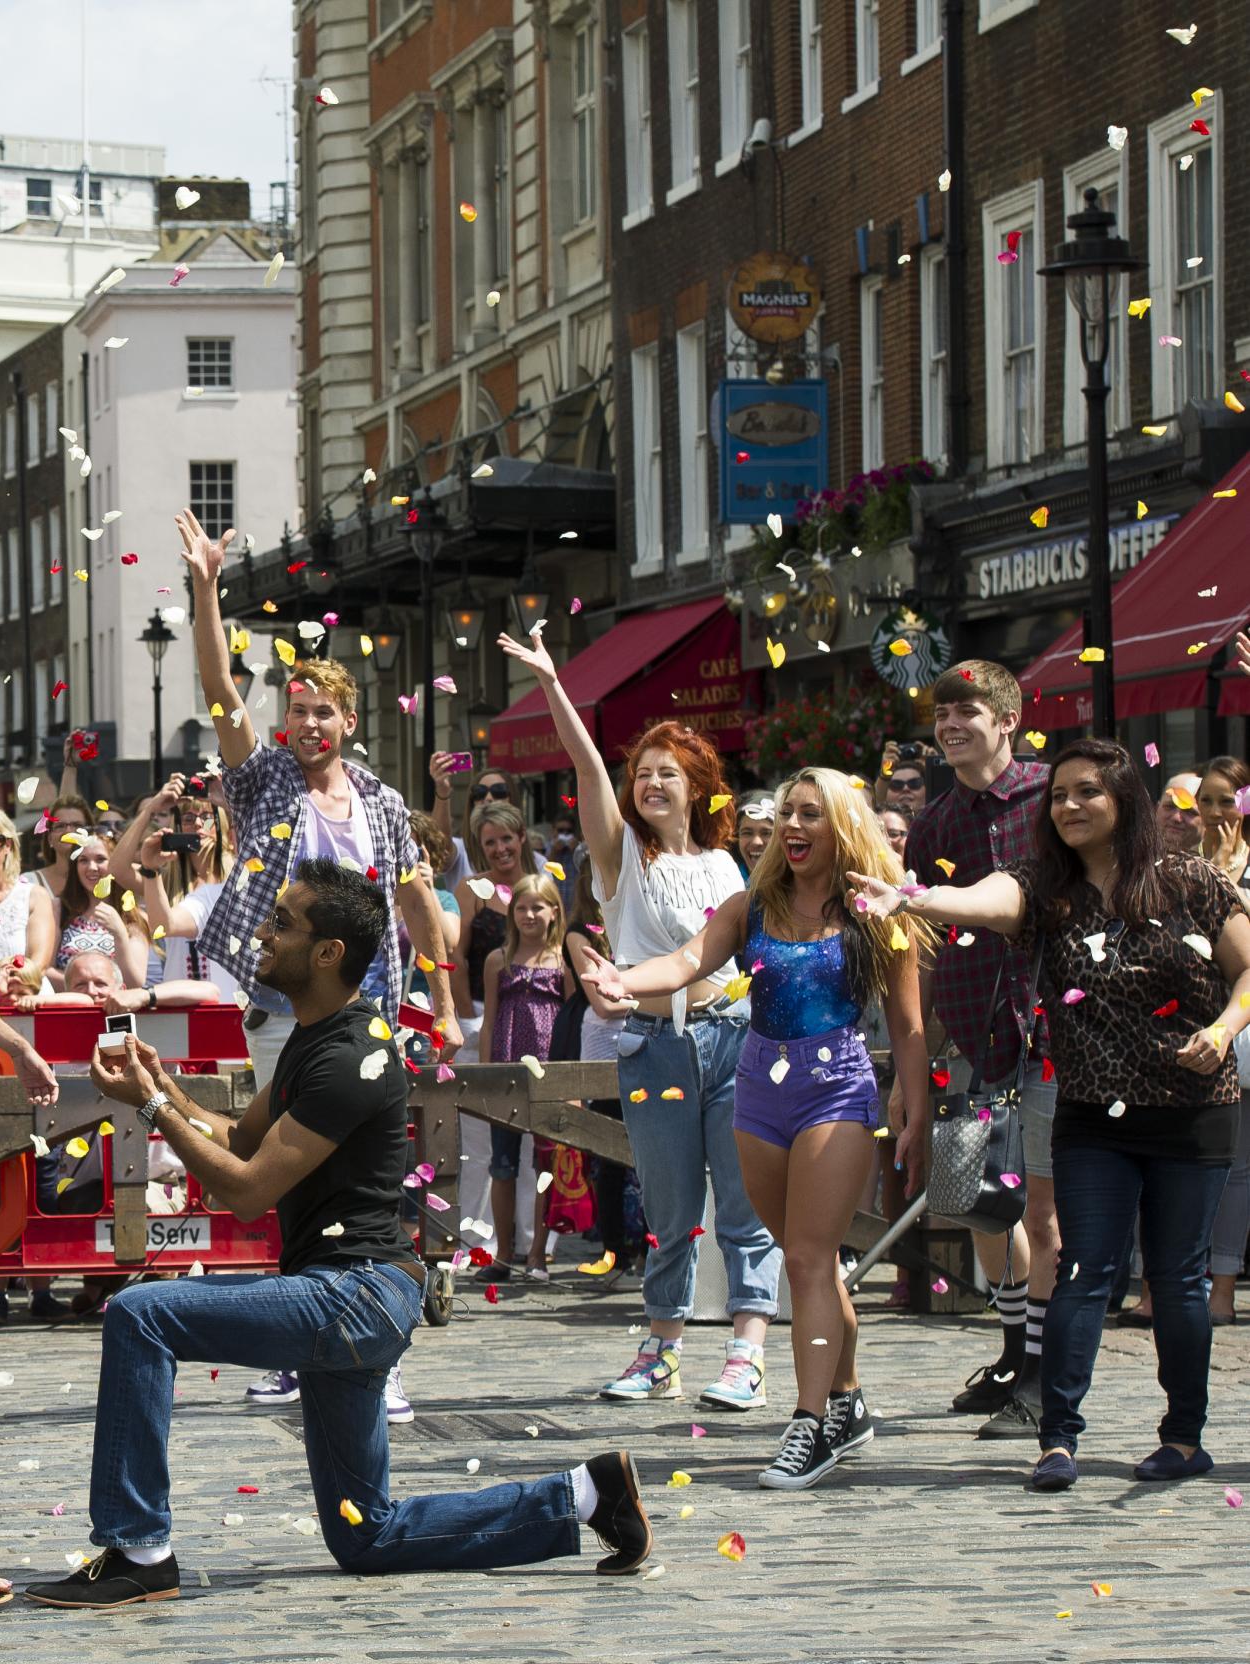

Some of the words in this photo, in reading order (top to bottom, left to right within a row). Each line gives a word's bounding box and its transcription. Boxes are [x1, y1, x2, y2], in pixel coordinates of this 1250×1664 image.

[742, 293, 808, 306] MAGNERS
[766, 480, 776, 499] &
[979, 540, 1087, 600] STARBUCKS
[700, 655, 738, 678] CAFÉ
[673, 684, 740, 707] SALADES
[513, 732, 565, 759] BALTHAZA
